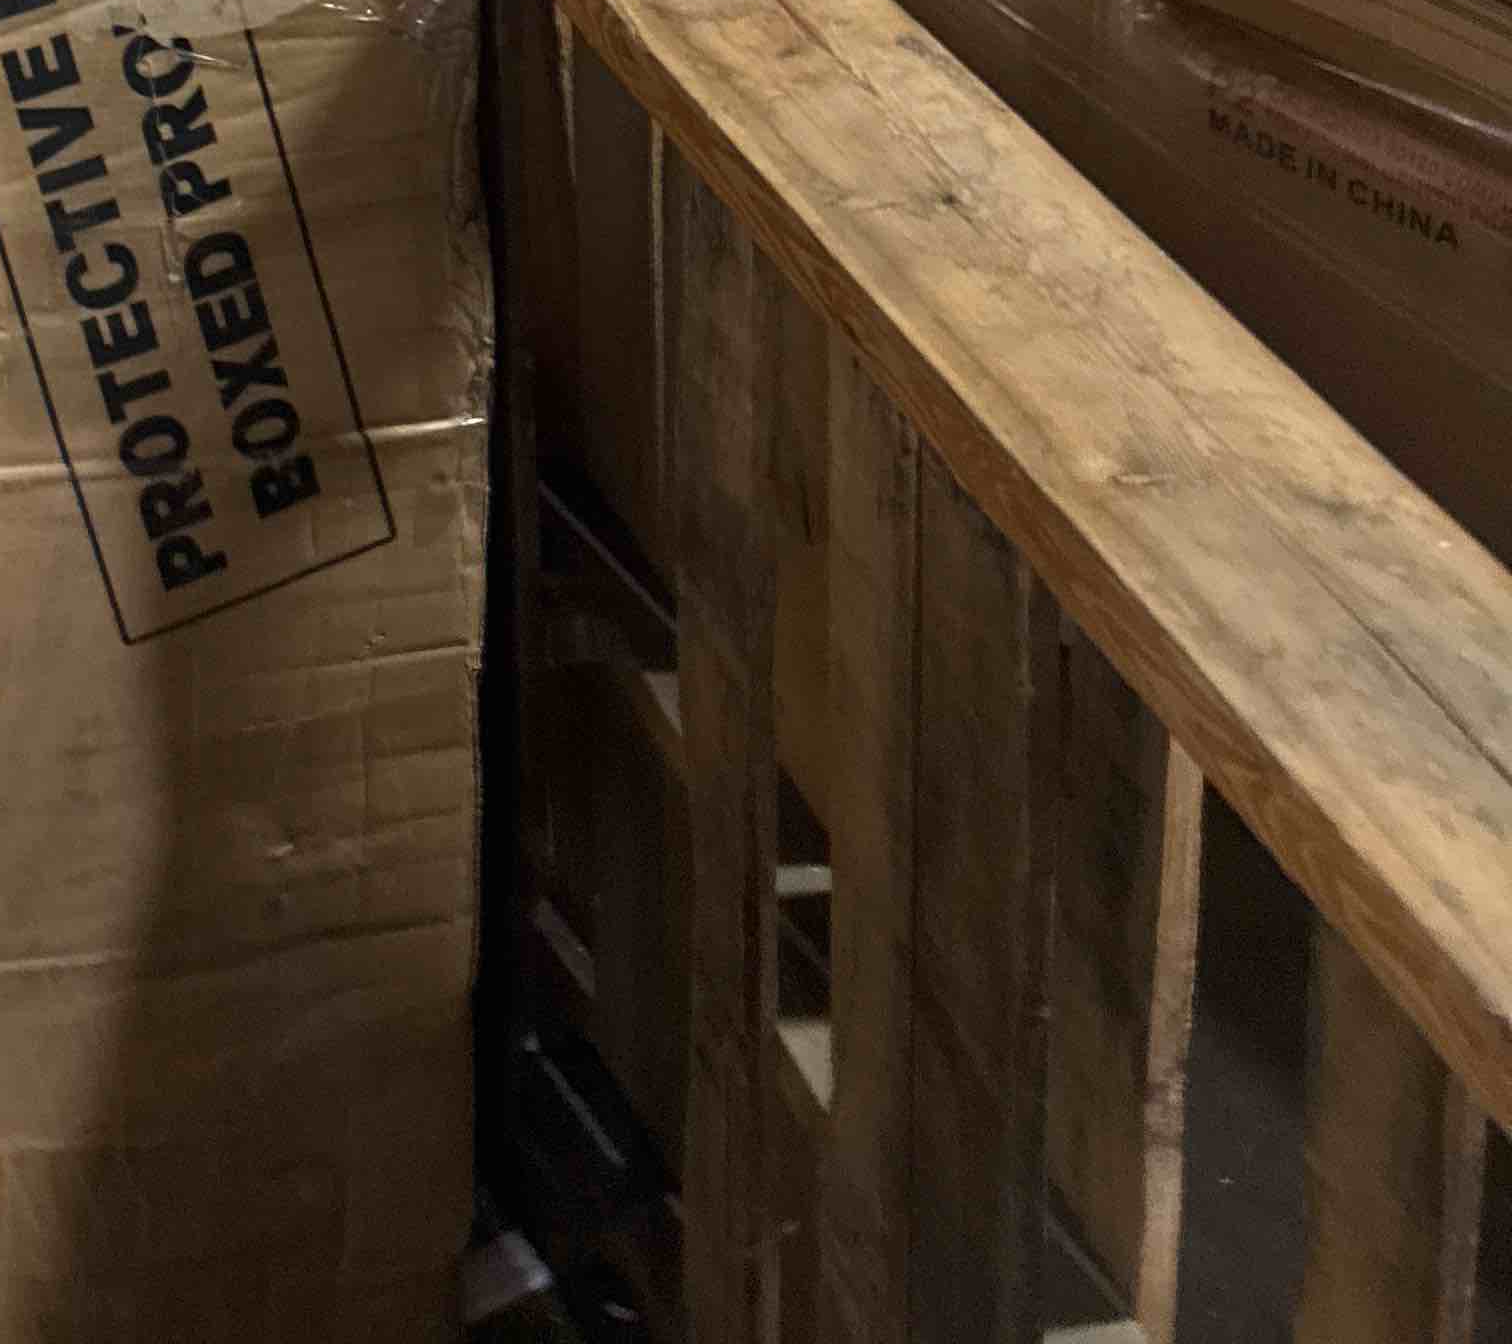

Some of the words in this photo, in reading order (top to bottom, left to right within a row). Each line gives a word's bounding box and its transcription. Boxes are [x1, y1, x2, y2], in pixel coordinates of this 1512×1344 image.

[0, 31, 228, 592] PROTECTIVE
[1207, 108, 1298, 173] MADE
[1306, 157, 1338, 191] IN
[1347, 178, 1461, 250] CHINA
[184, 231, 321, 519] BOXED
